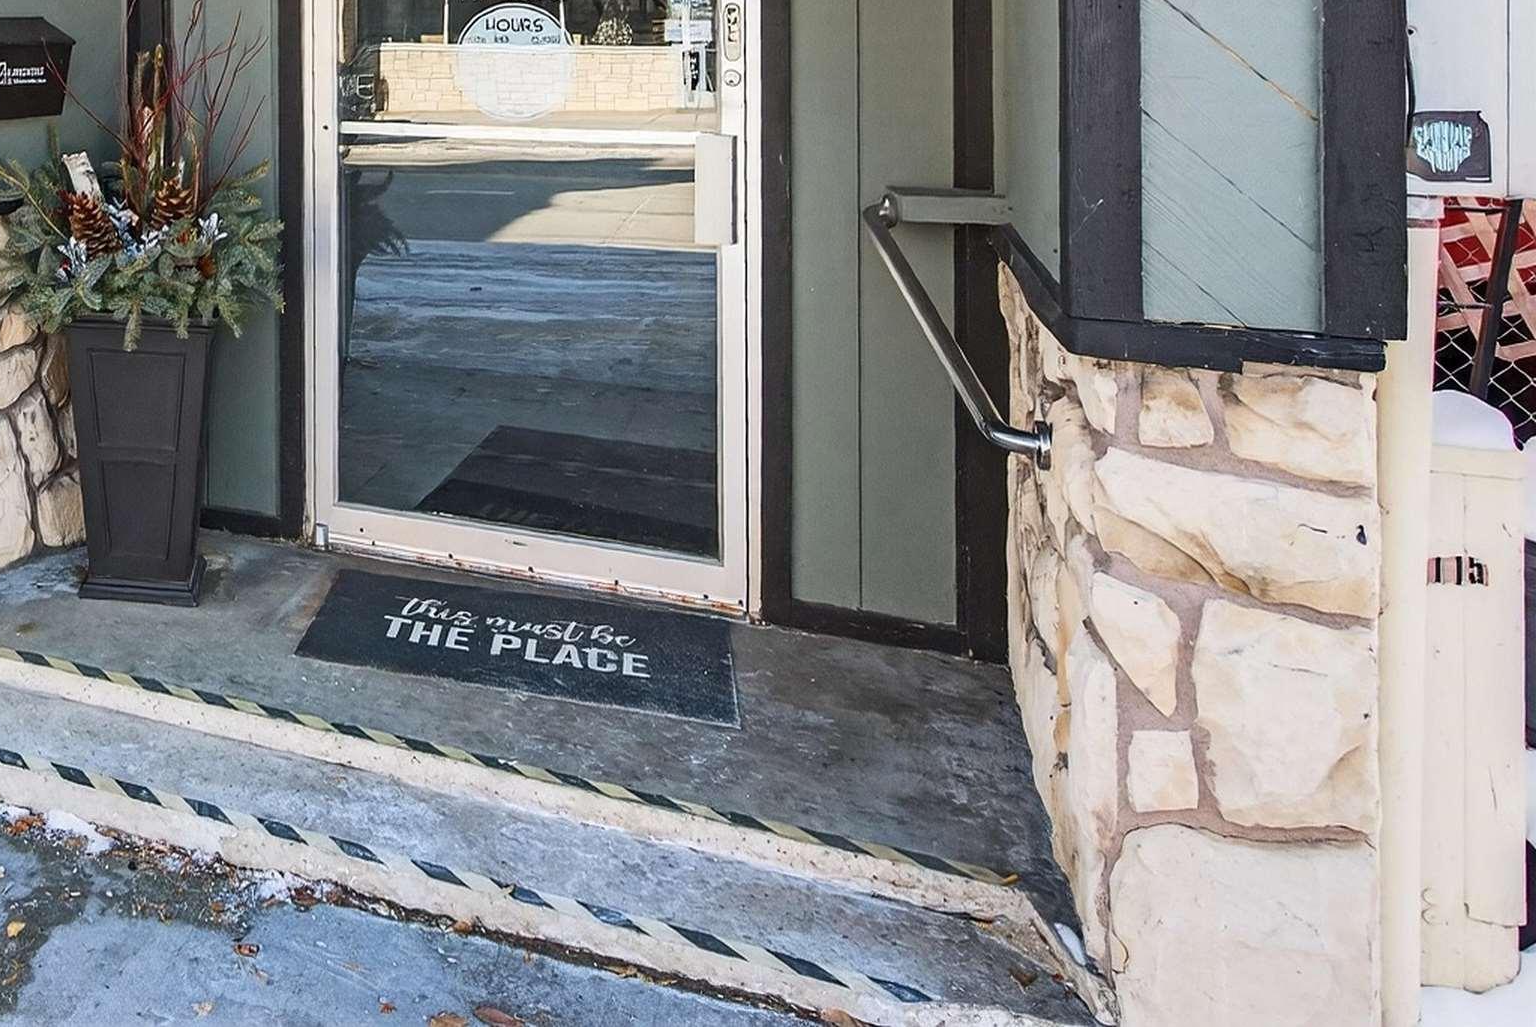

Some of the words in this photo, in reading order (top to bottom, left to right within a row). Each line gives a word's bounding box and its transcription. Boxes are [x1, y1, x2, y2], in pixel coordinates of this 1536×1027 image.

[485, 18, 544, 33] HOURS
[384, 615, 475, 651] THE
[490, 633, 651, 678] PLACE
[486, 615, 584, 643] must
[590, 625, 637, 648] be
